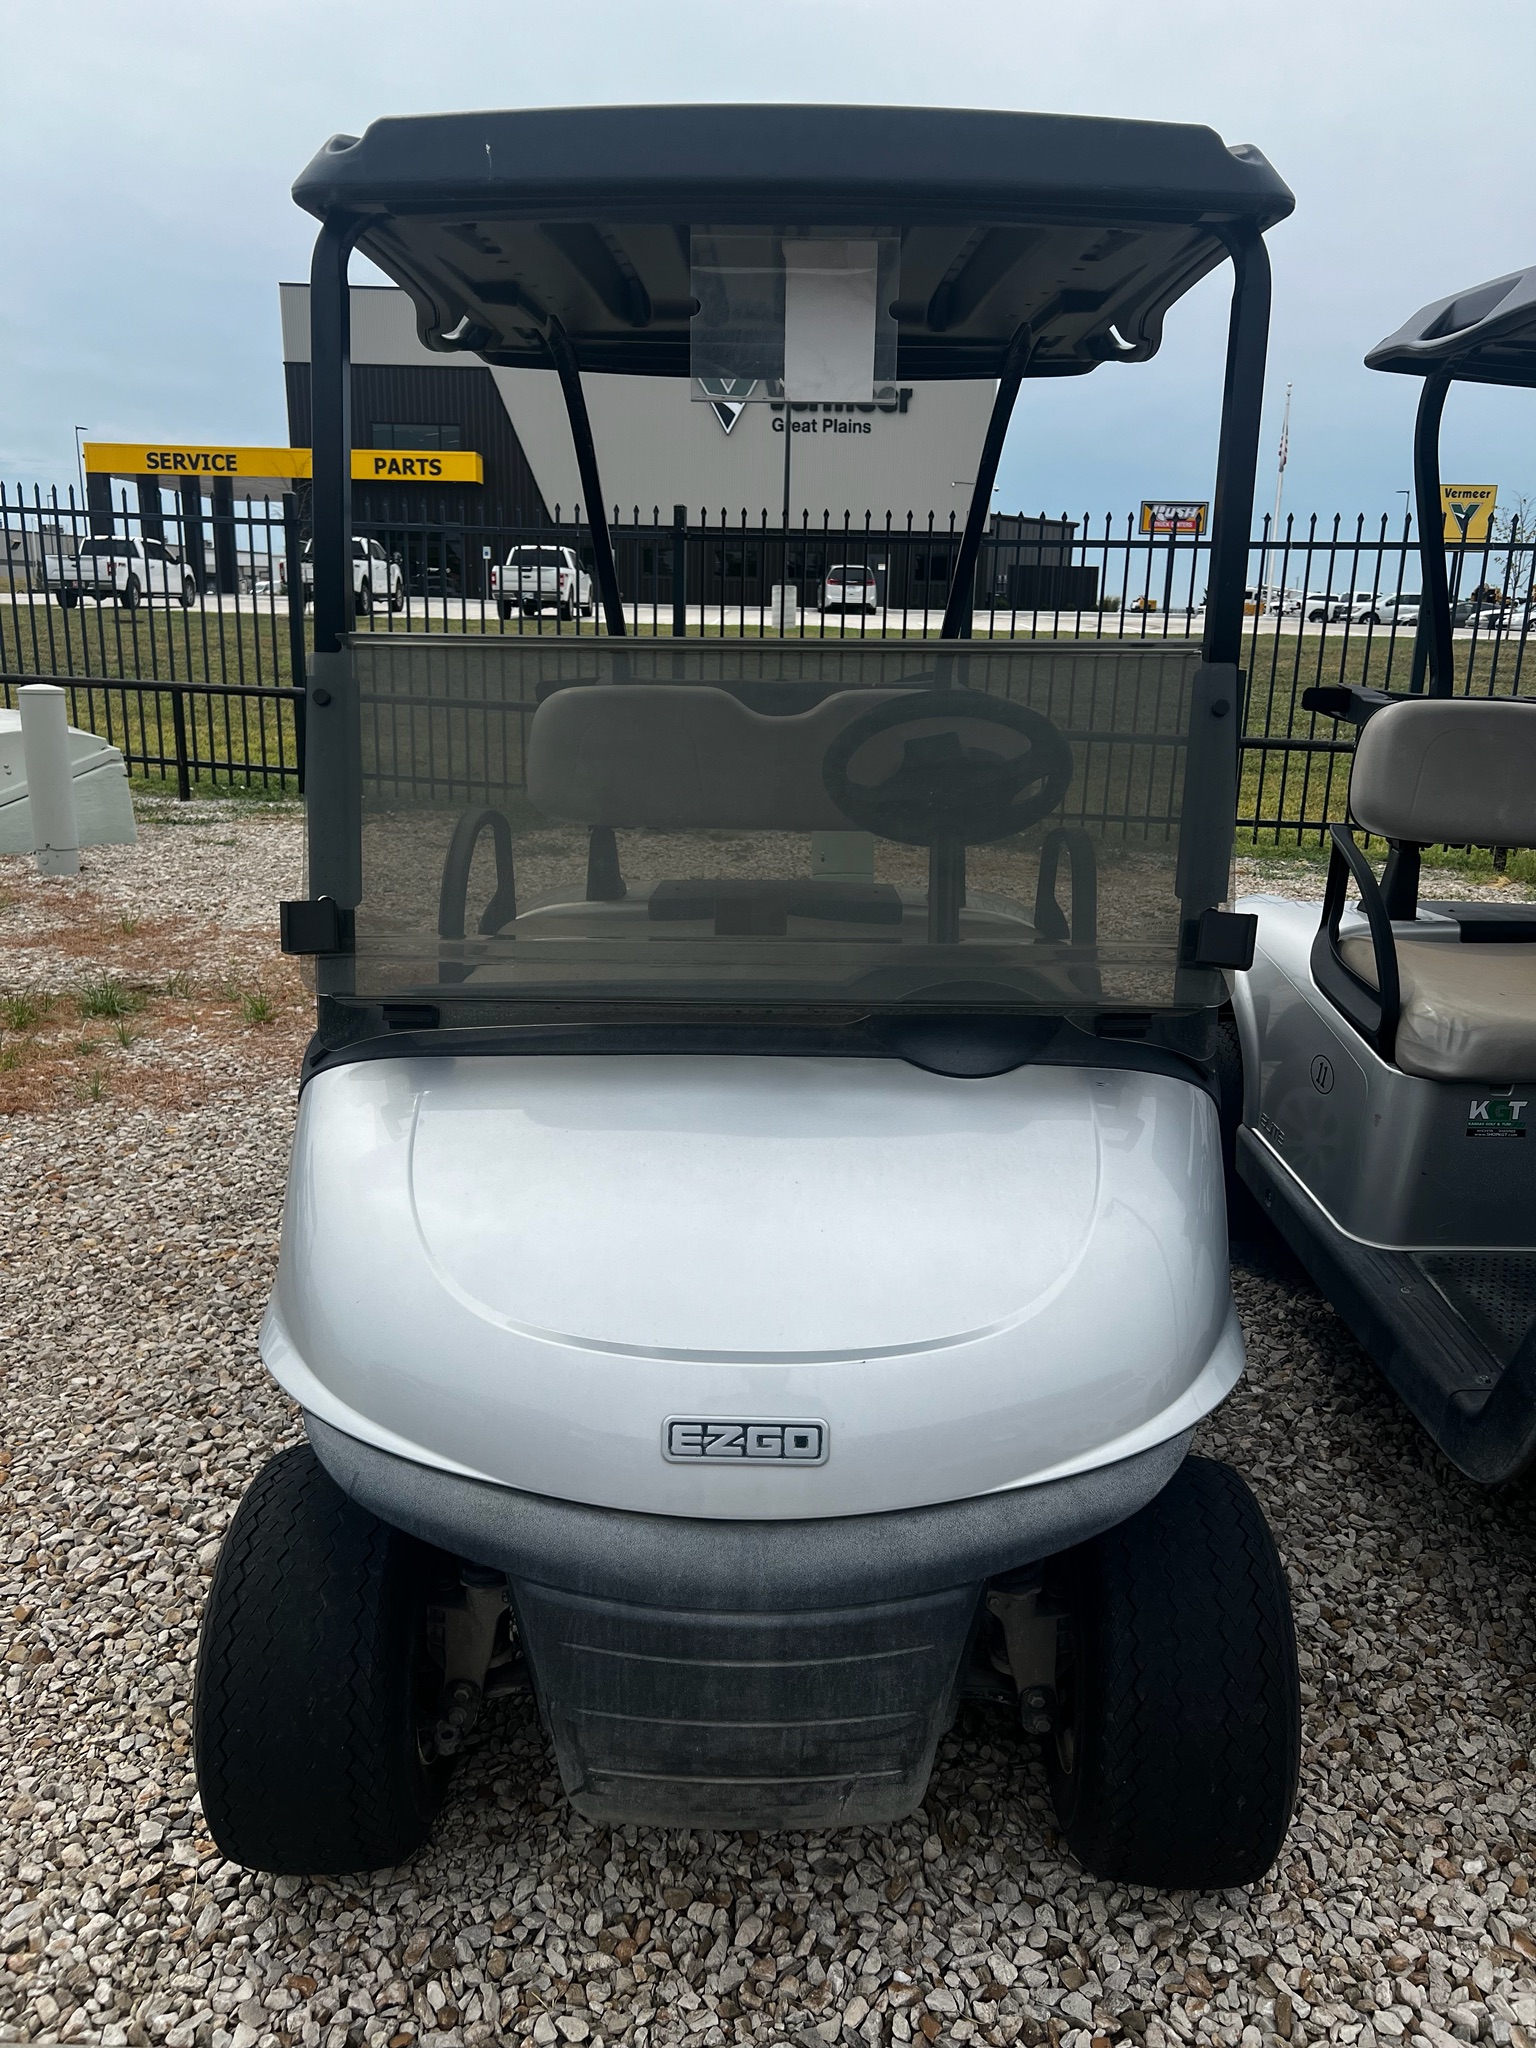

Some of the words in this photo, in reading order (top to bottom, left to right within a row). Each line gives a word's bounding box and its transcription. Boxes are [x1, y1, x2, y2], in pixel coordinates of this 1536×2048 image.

[771, 417, 818, 433] Geat
[822, 418, 872, 434] Plains
[146, 452, 238, 471] SERVICE
[374, 457, 442, 476] PARTS
[1444, 488, 1492, 499] Vermeer
[1469, 1100, 1528, 1120] KGT
